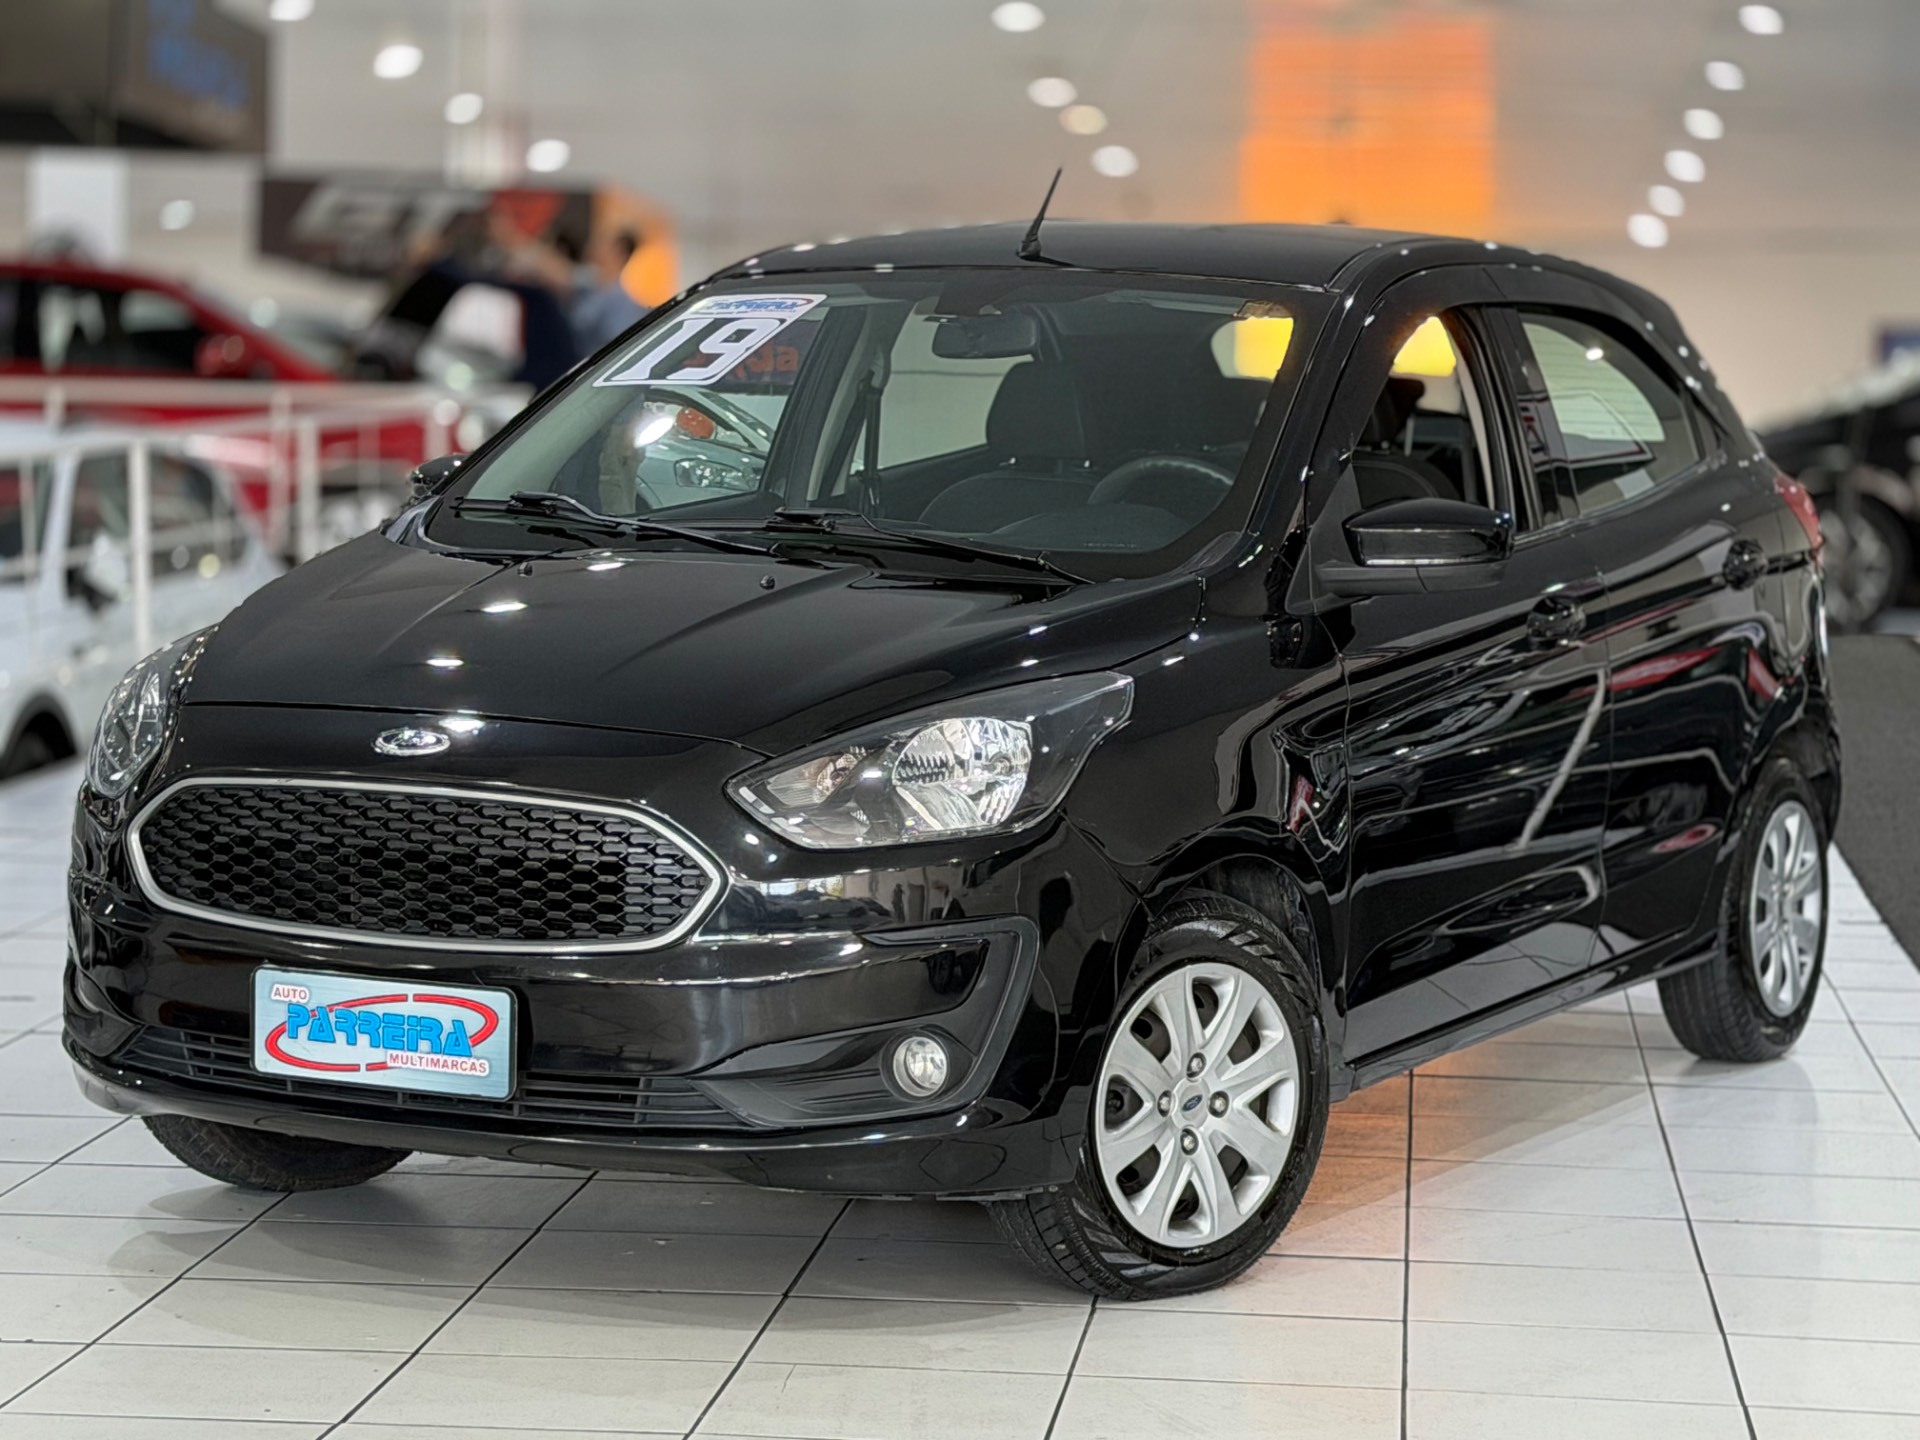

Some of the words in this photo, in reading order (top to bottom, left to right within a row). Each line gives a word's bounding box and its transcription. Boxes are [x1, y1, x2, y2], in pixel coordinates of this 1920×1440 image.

[610, 318, 781, 380] 19
[273, 986, 308, 1000] AUTO
[287, 1003, 473, 1058] PARREIRA
[388, 1053, 487, 1074] MULTIMARCAS
